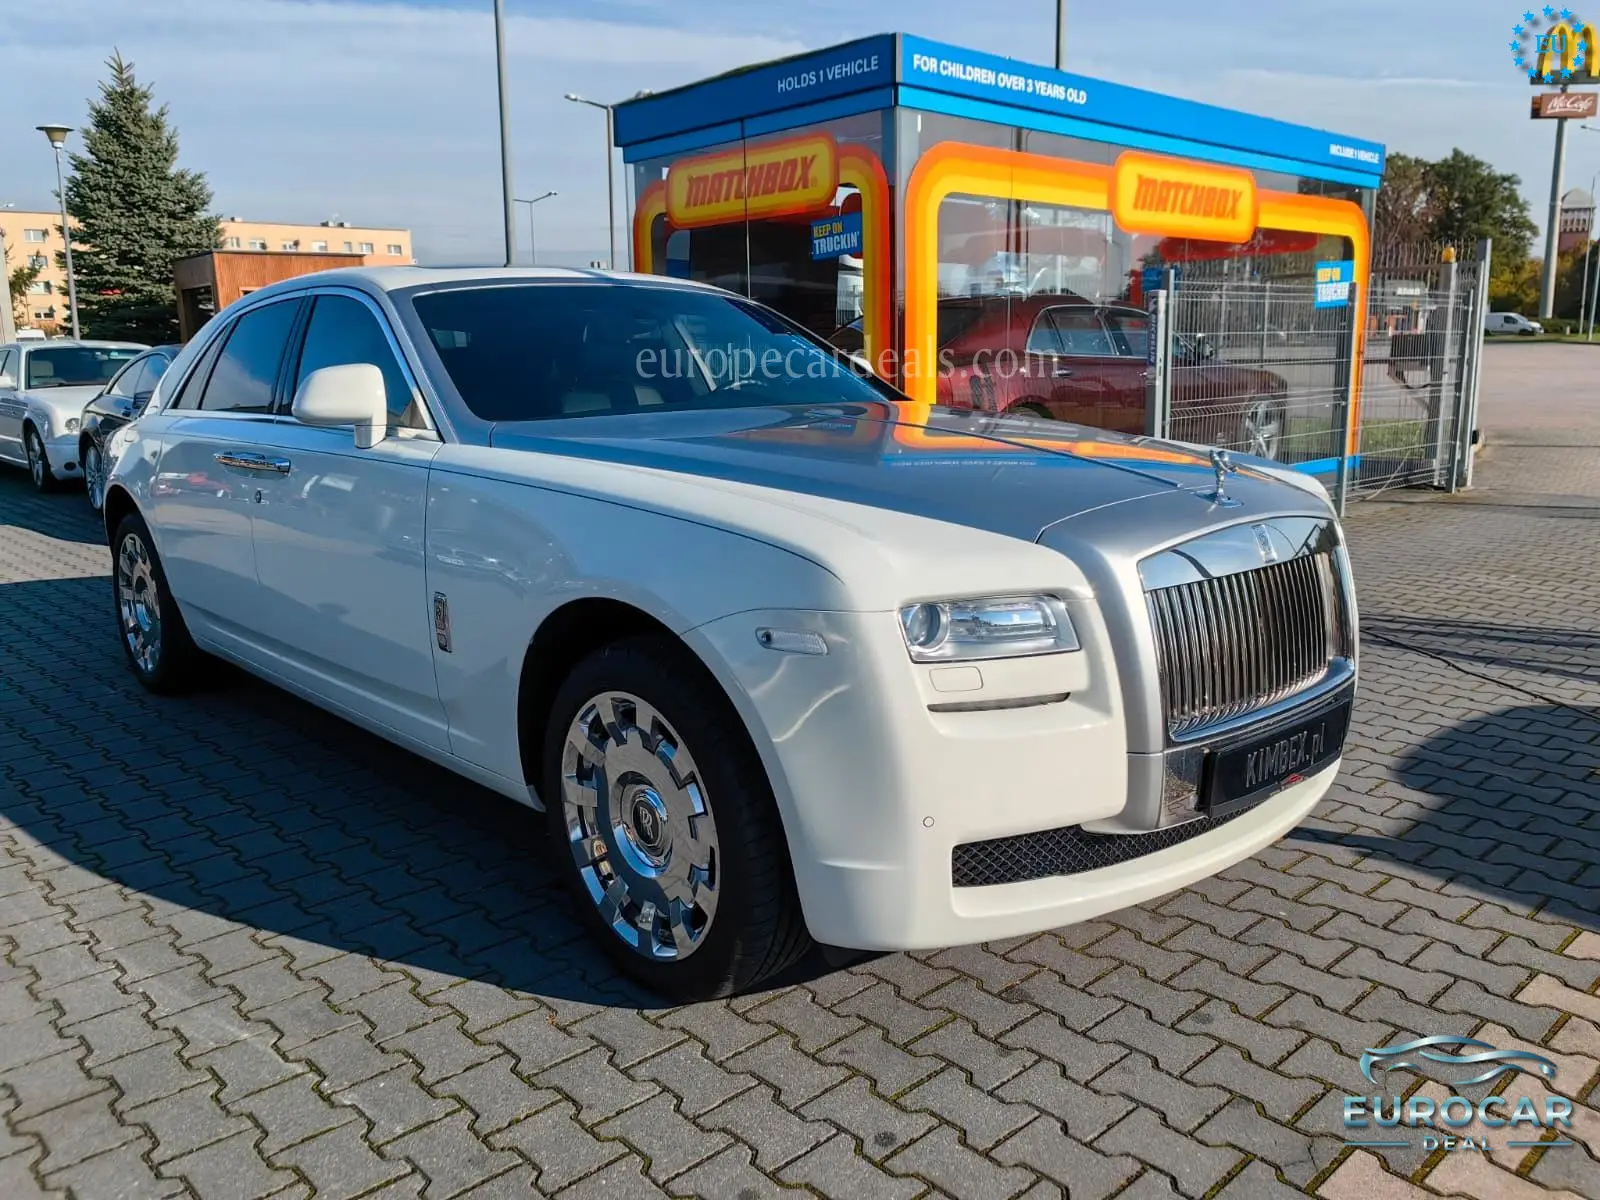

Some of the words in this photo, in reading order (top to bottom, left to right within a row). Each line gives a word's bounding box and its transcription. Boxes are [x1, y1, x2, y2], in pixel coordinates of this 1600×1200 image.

[777, 71, 817, 93] HOLDS
[819, 69, 824, 83] 1
[826, 55, 879, 80] VEHICLE
[912, 53, 938, 73] FOR
[939, 59, 996, 87] CHILDREN
[997, 72, 1026, 92] OVER
[1026, 79, 1033, 93] 3
[1034, 80, 1065, 100] YEARS
[1066, 89, 1087, 105] OLD
[685, 154, 817, 209] MATCHBOX
[1133, 173, 1244, 220] MATCHBOX
[813, 223, 831, 239] KEEP
[832, 221, 843, 235] ON
[1246, 722, 1326, 789] KIMBEX.pl
